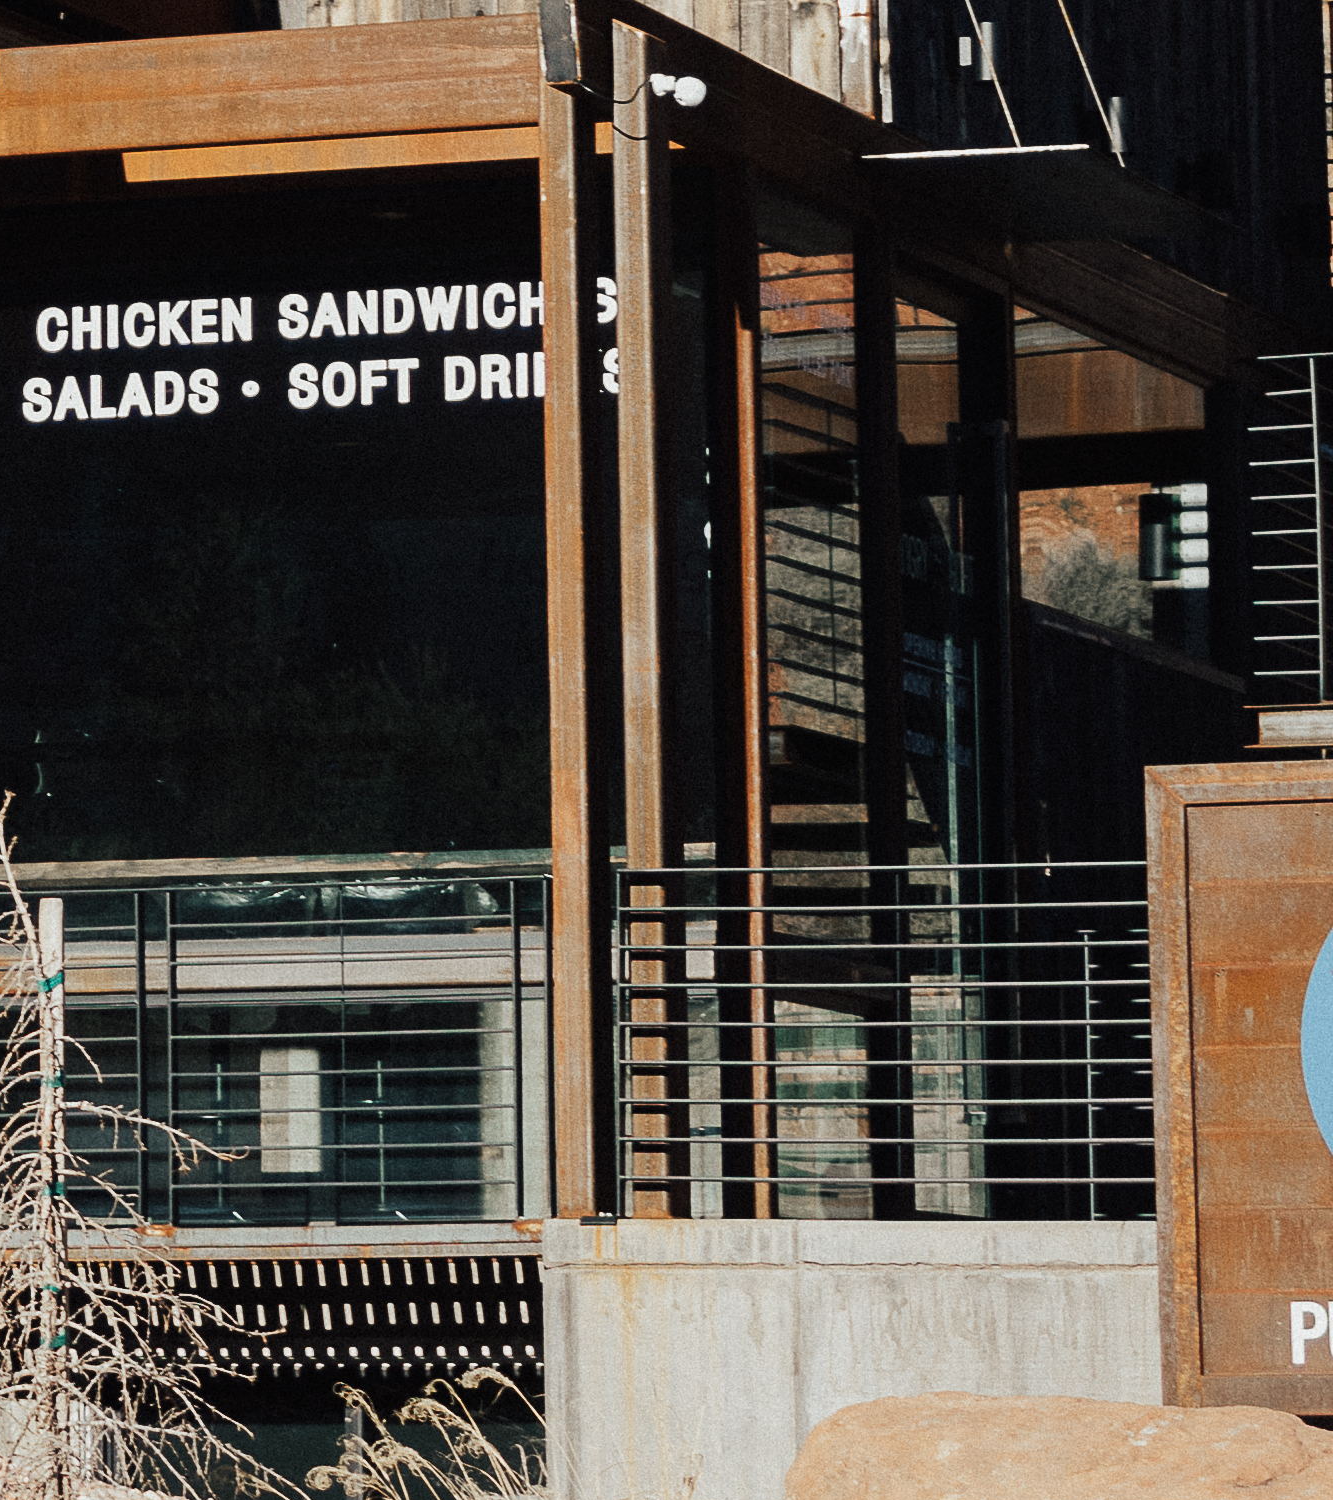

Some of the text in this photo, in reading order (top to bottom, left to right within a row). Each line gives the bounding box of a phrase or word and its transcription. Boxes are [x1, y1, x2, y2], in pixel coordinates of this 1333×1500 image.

[36, 277, 617, 353] CHICKEN SANDWICHS
[21, 348, 619, 422] SALADS SOFT DRIS
[1289, 1300, 1333, 1366] P
